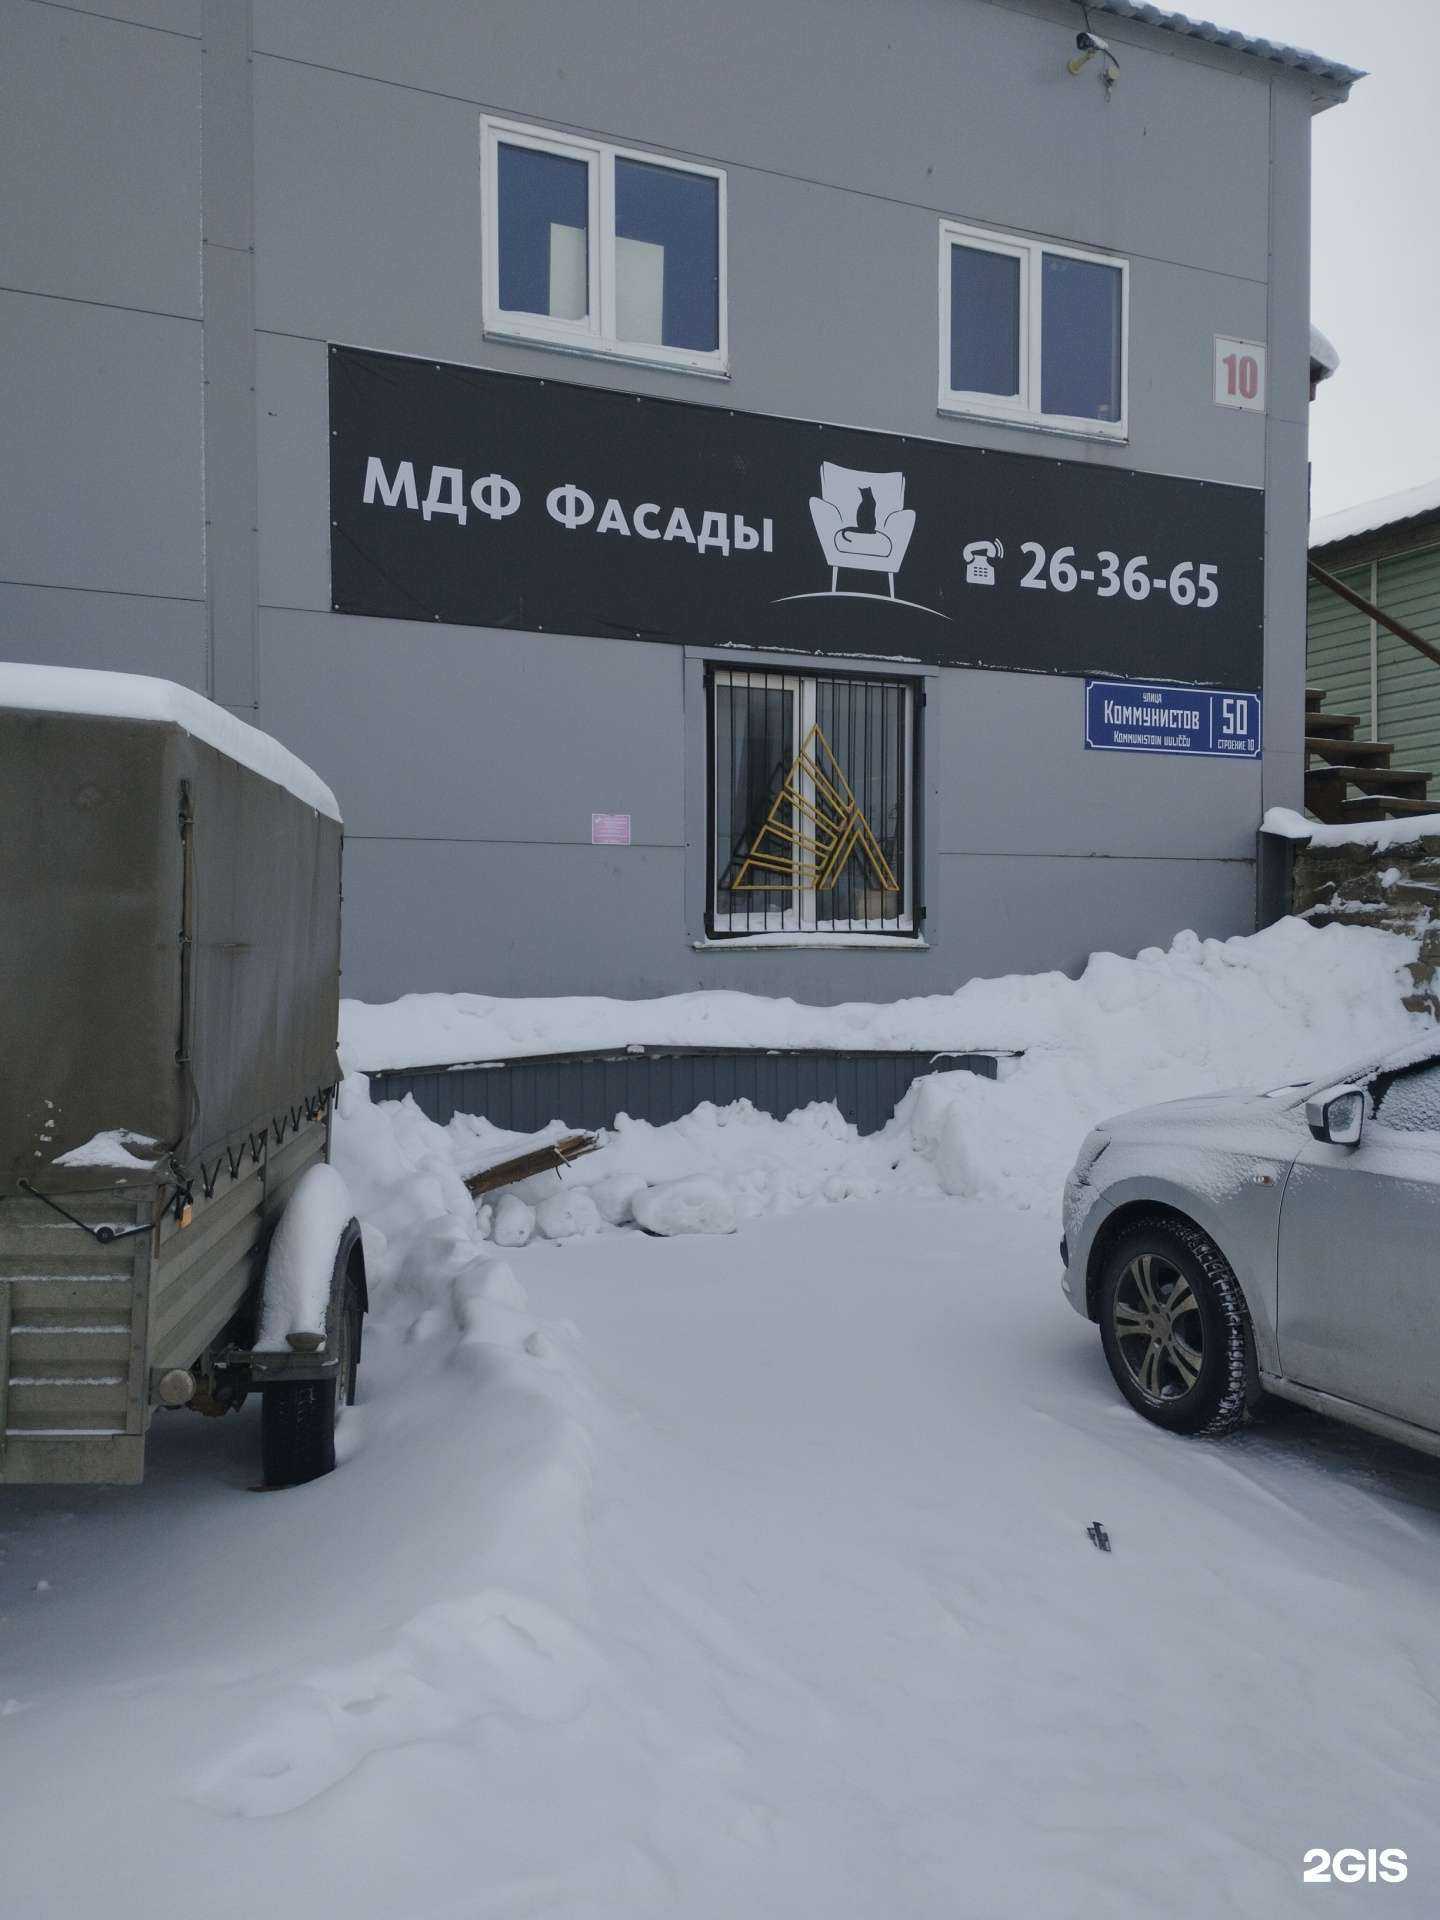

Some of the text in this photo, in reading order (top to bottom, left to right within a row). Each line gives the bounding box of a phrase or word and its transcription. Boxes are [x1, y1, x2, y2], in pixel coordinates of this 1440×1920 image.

[1222, 353, 1258, 400] 10
[362, 456, 521, 526] МДФ
[1020, 541, 1219, 608] 26-36-65
[1222, 699, 1248, 735] 50
[1247, 738, 1255, 751] 10
